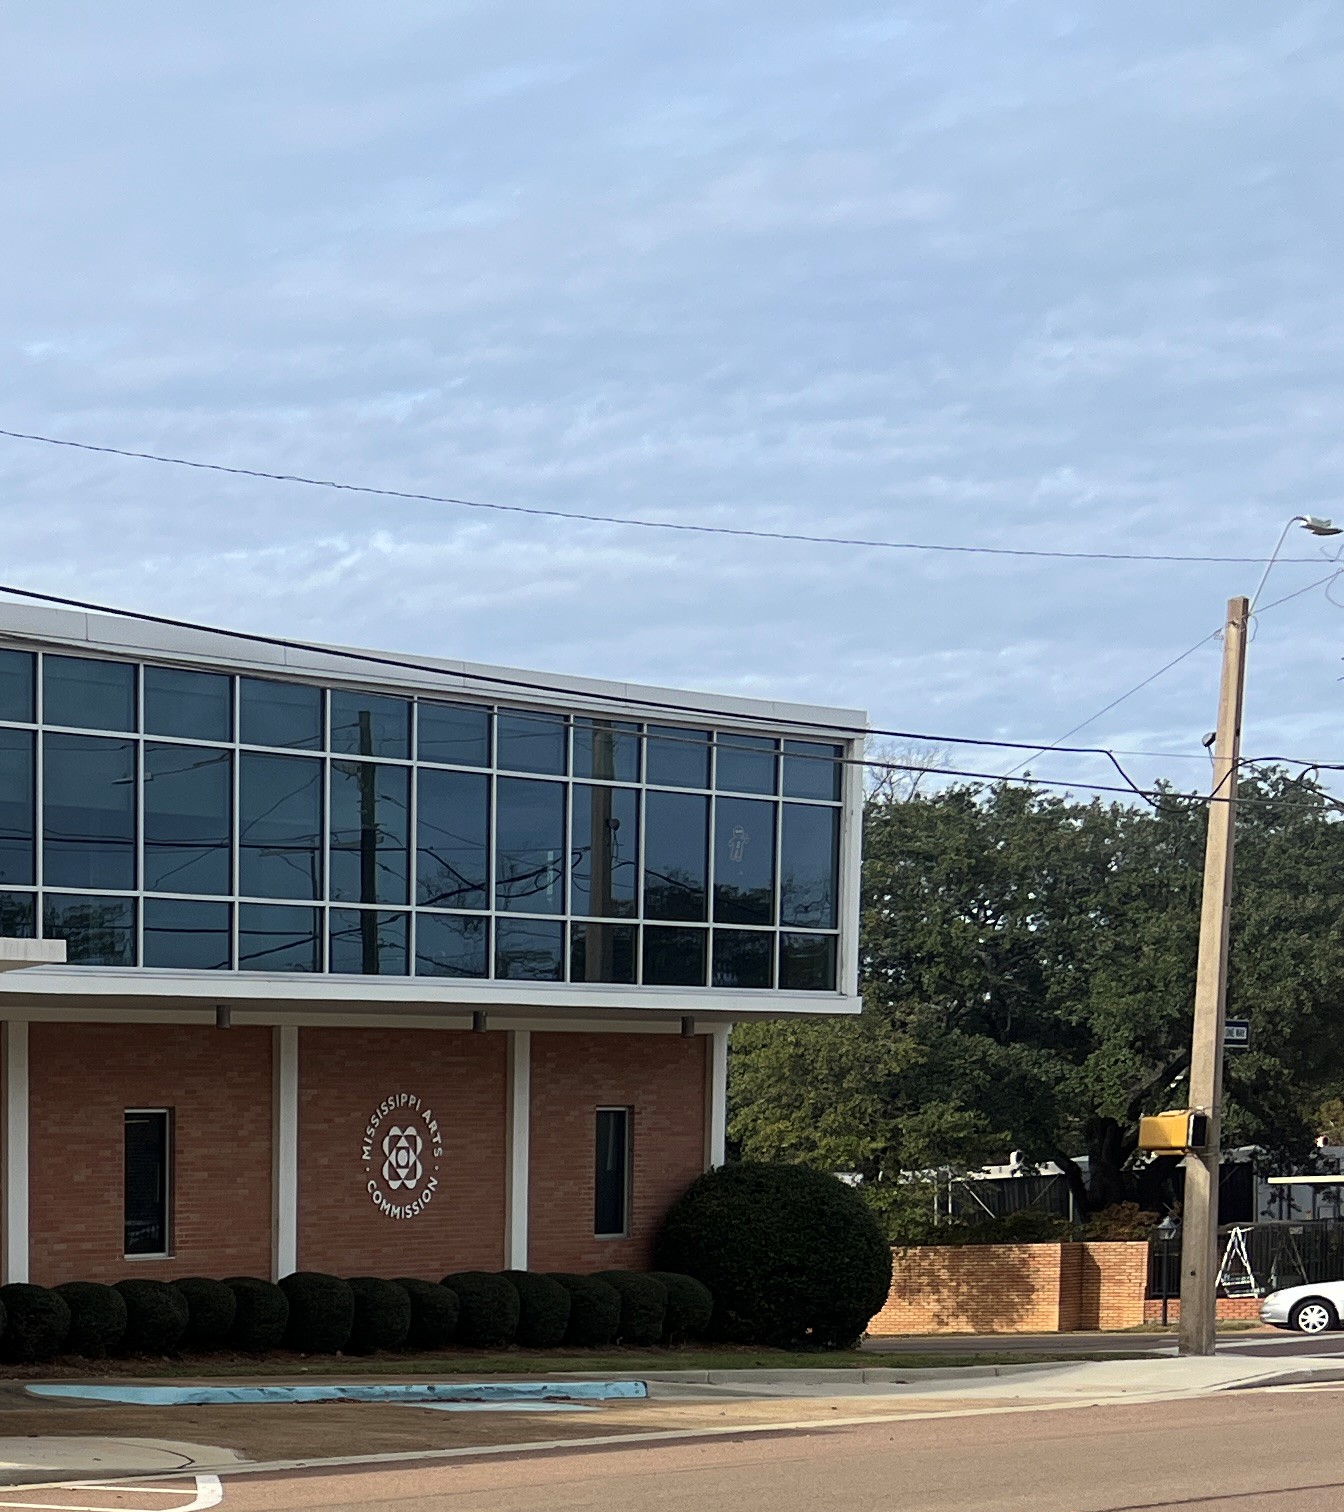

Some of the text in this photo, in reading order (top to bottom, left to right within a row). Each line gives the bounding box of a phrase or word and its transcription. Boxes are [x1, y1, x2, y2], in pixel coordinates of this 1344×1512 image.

[362, 1093, 443, 1220] MISSISSIPPI ARTS COMMISSION
